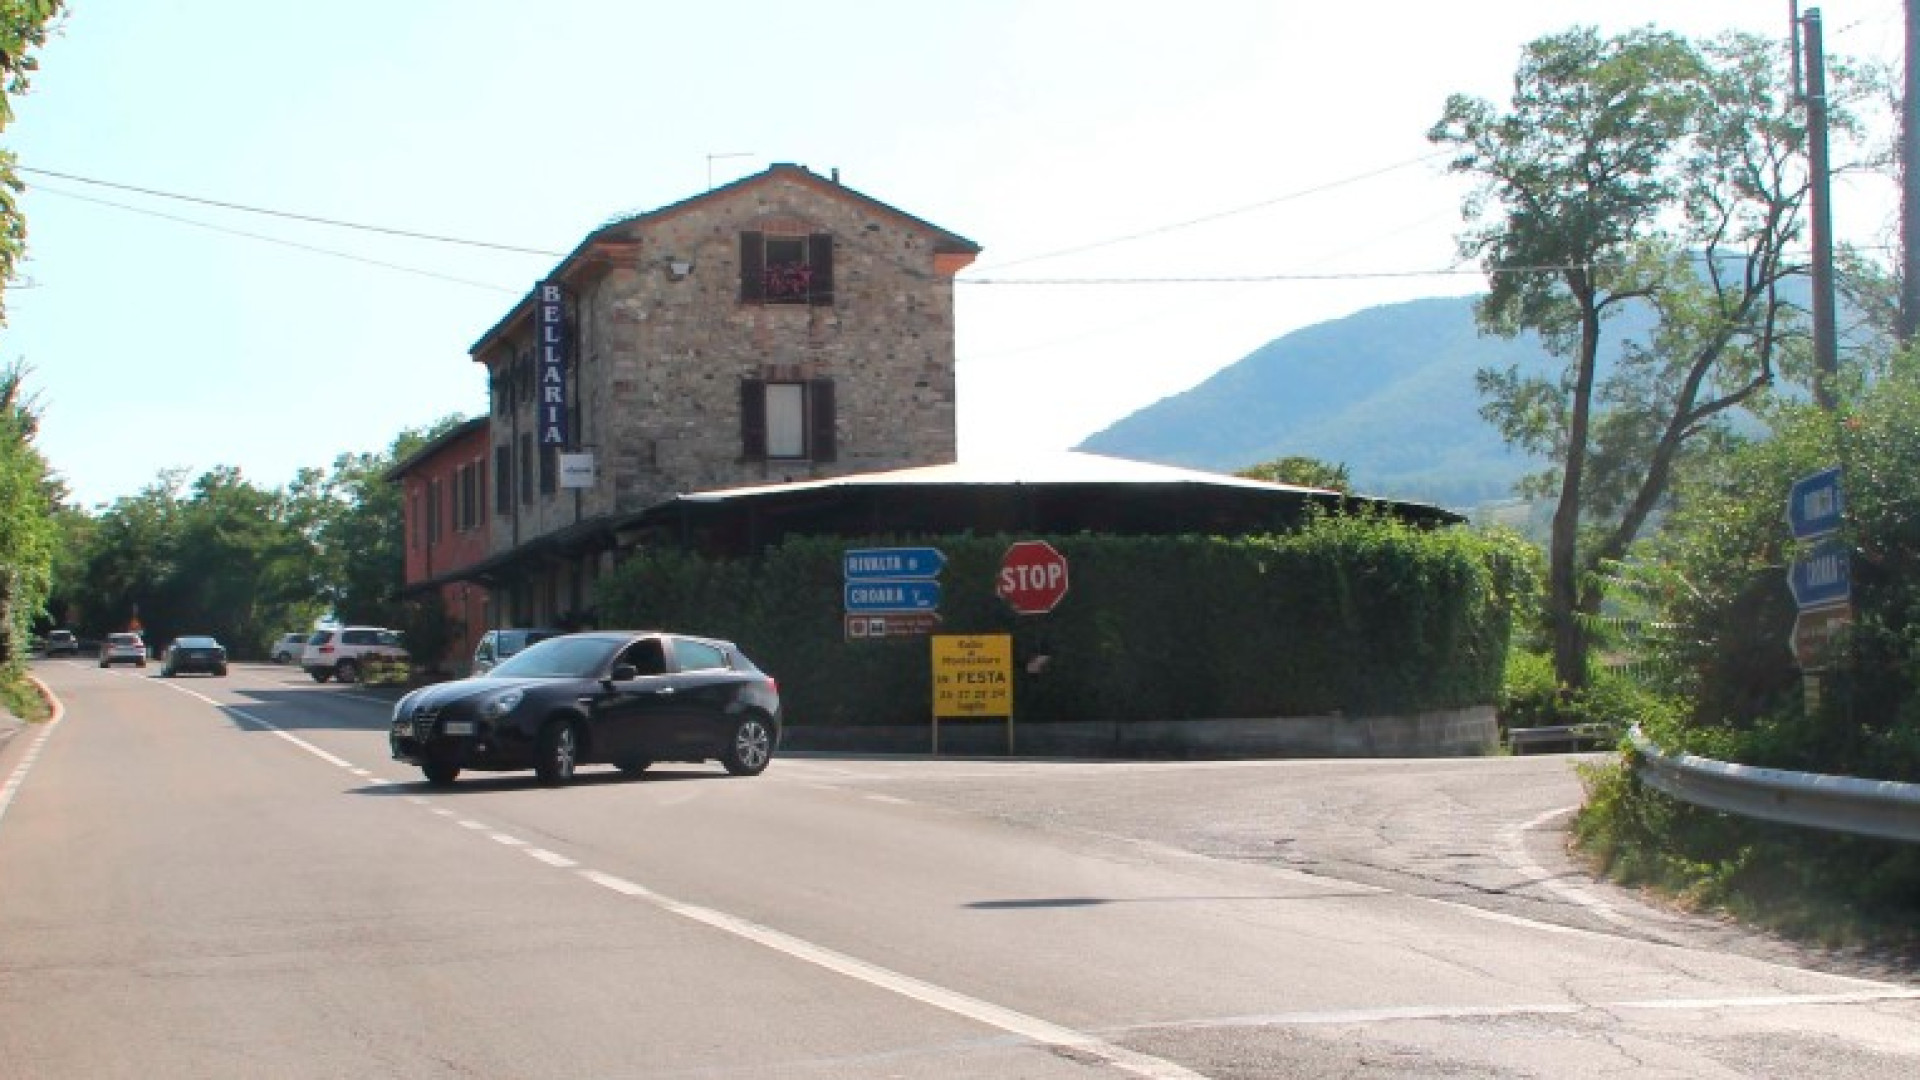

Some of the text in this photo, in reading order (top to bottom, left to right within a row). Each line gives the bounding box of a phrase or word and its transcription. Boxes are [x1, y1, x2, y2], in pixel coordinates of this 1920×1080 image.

[542, 285, 563, 443] BELLARIA
[848, 555, 902, 572] RIVALTA
[1002, 563, 1061, 593] STOP
[851, 588, 904, 603] CROARA
[956, 671, 1006, 684] FESTA
